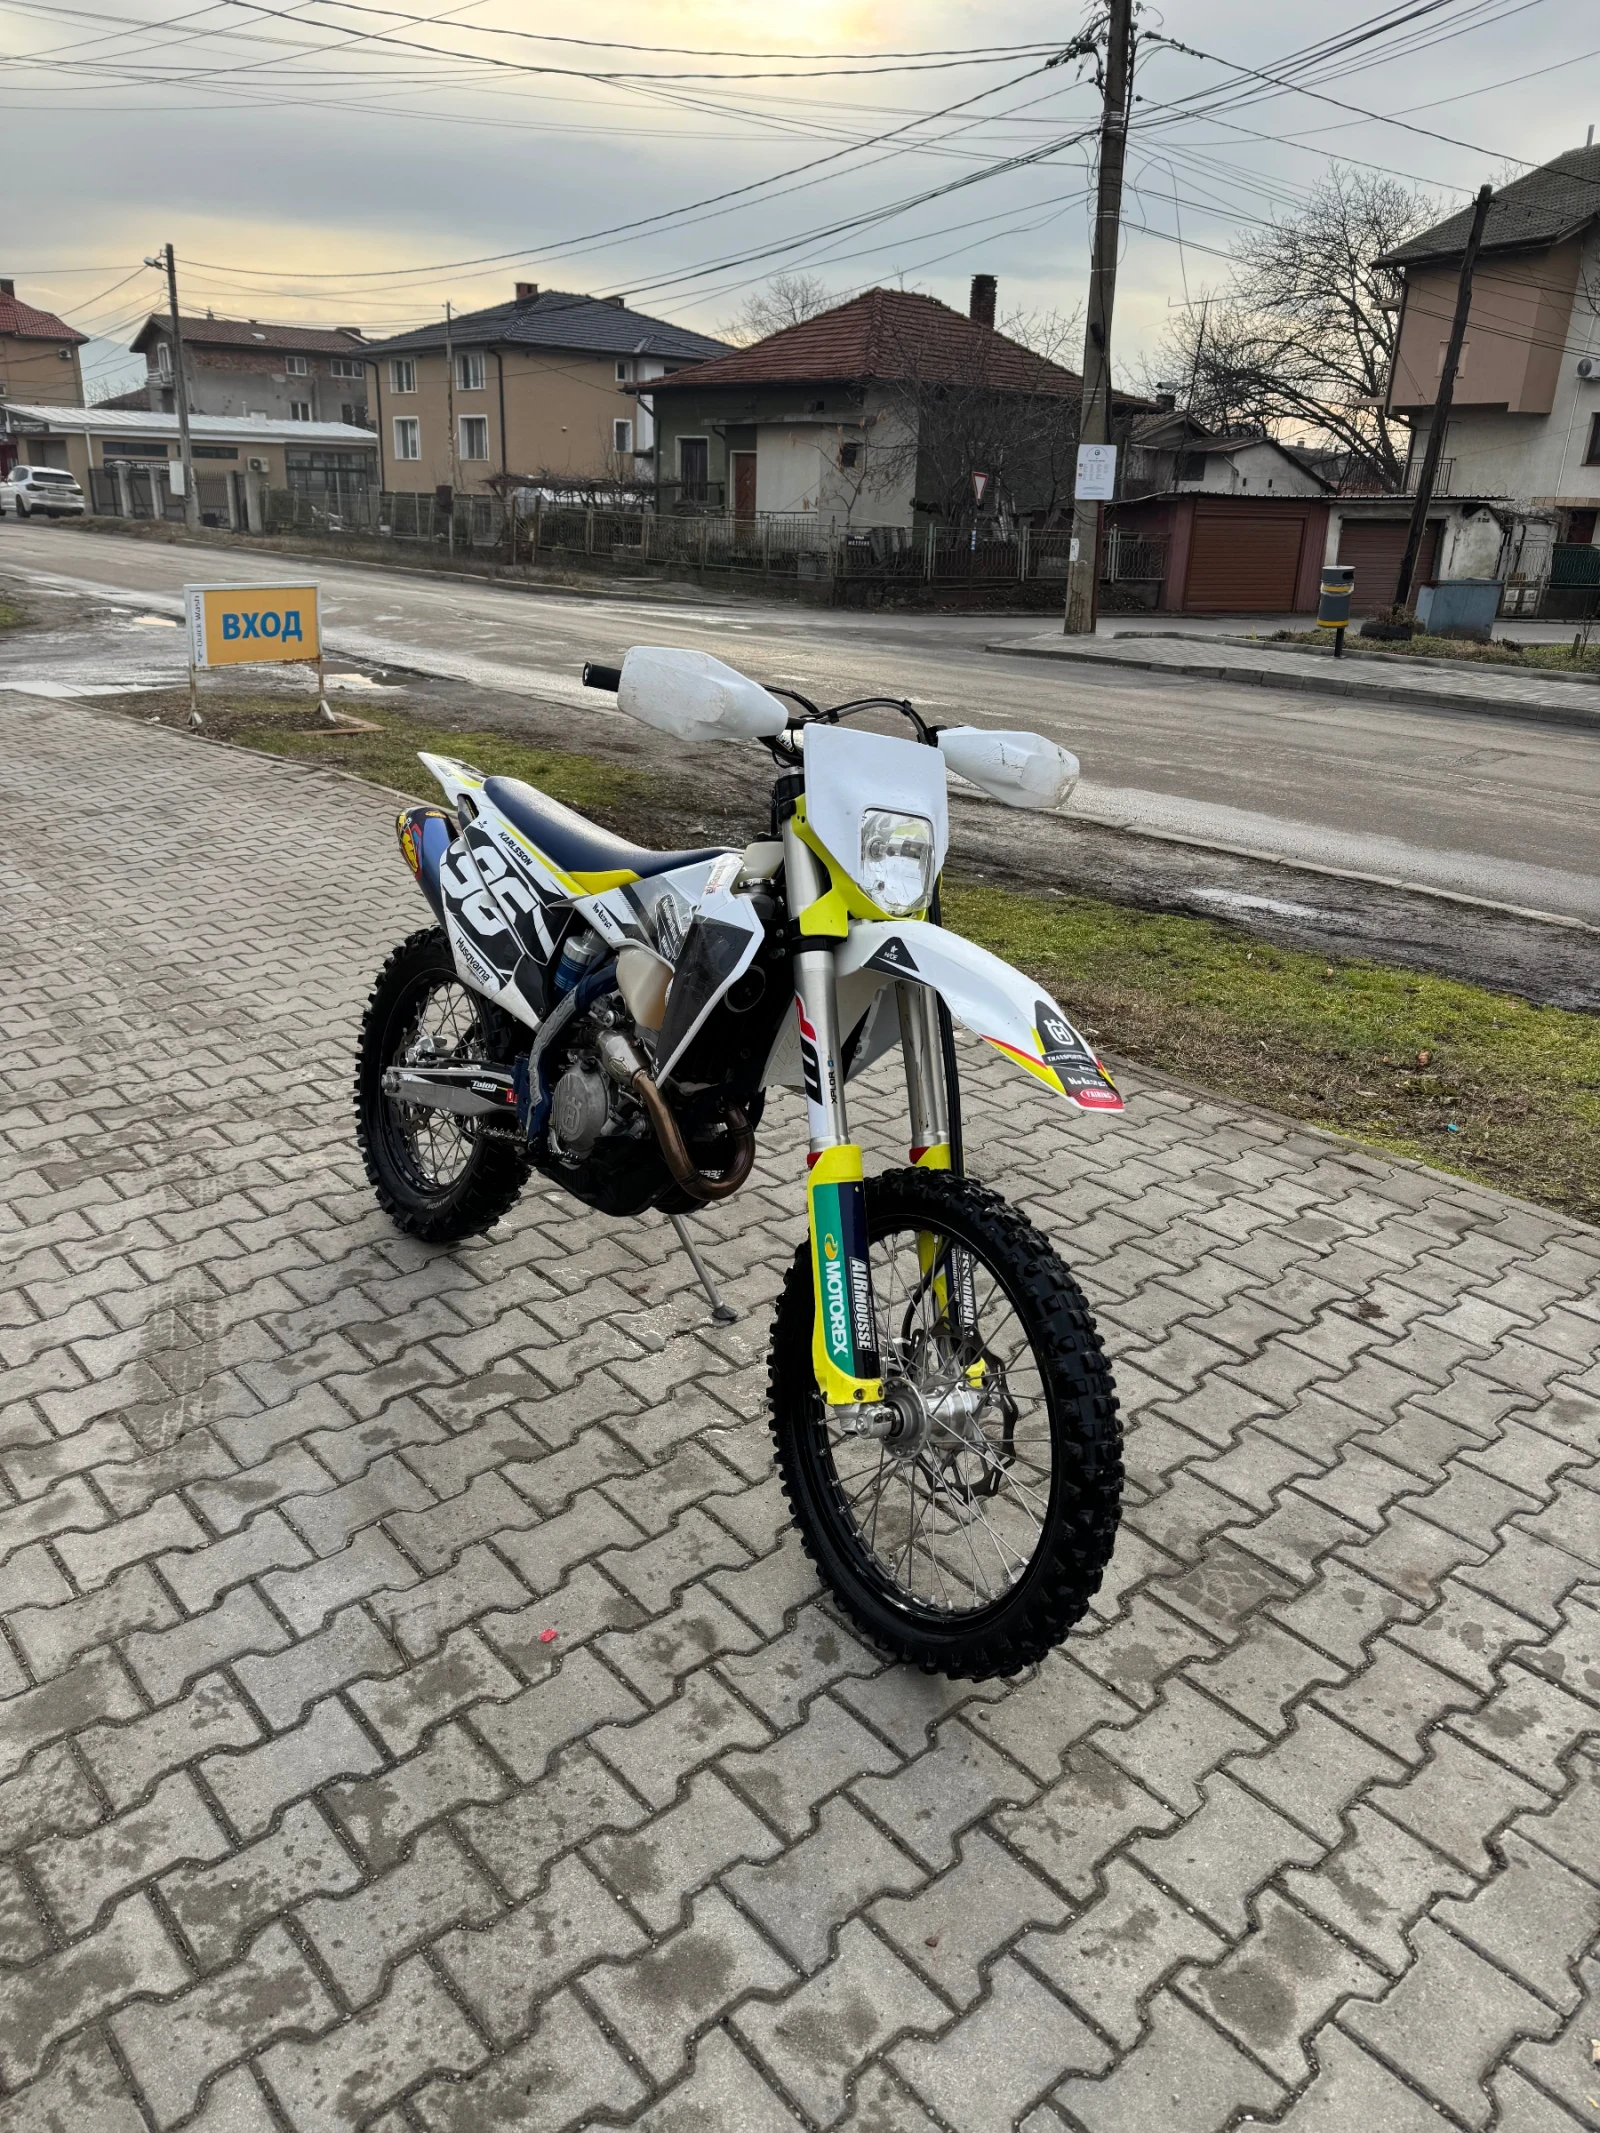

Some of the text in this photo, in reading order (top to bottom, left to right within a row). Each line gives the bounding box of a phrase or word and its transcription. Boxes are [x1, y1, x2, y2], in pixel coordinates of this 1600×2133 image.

[222, 611, 302, 643] ВХОД
[498, 831, 533, 867] KARLSSON
[455, 937, 491, 982] Husqvarna
[825, 1260, 849, 1356] MOTOREX
[851, 1259, 871, 1350] AIRMOUSSE
